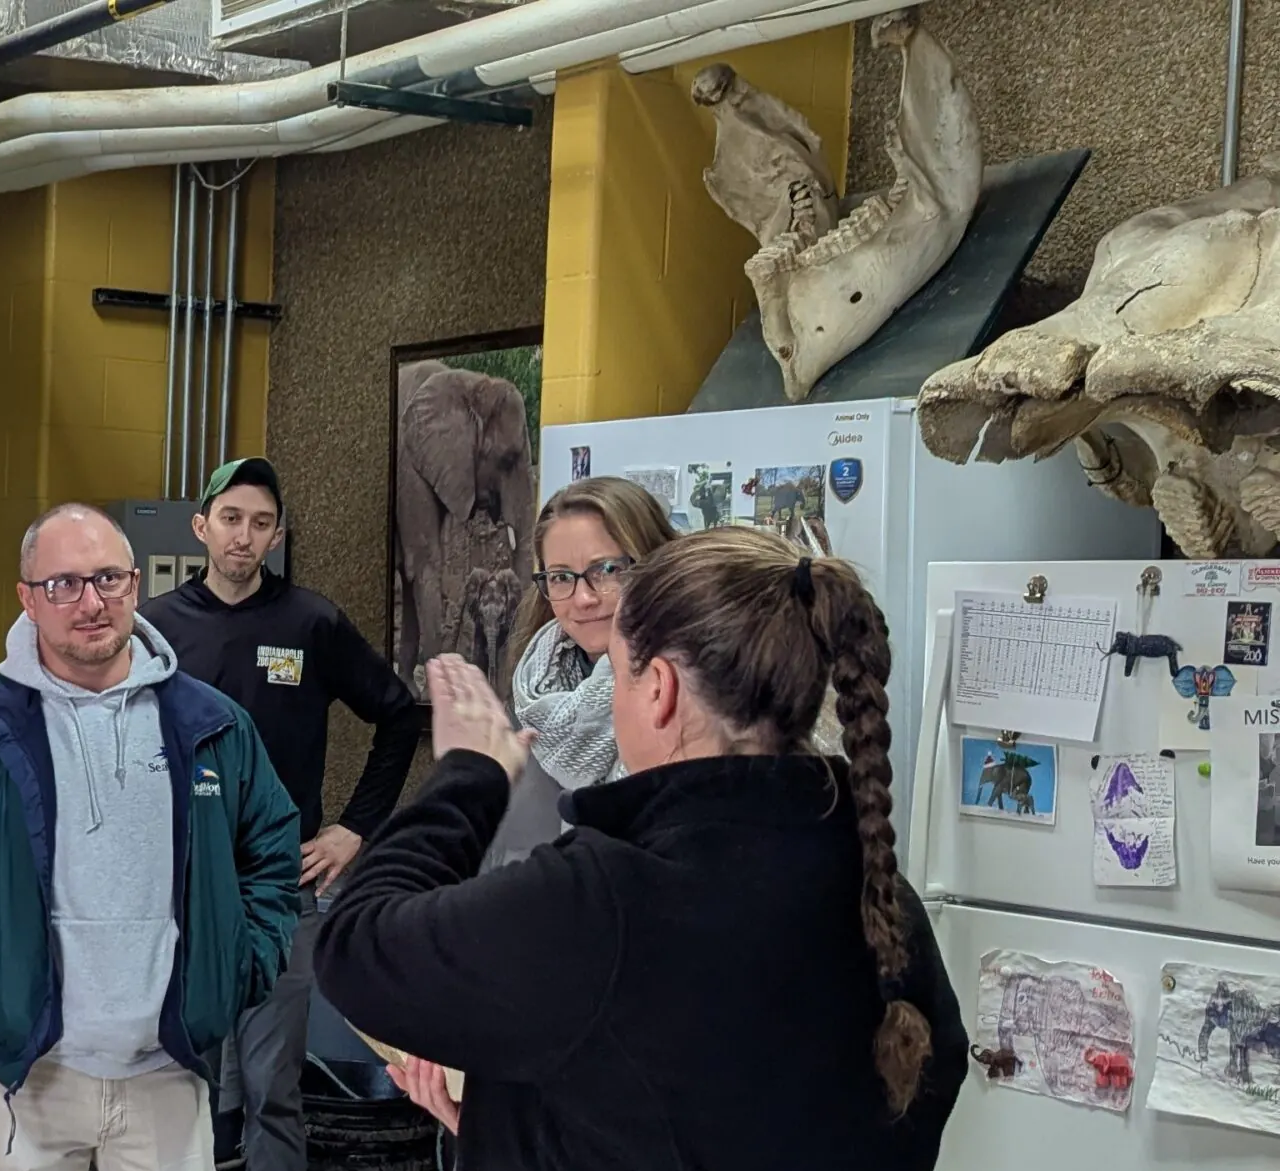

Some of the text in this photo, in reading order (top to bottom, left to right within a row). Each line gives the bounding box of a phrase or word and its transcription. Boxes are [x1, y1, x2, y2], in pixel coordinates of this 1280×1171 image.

[835, 413, 870, 422] Animal Only
[828, 431, 863, 446] Midea
[842, 467, 849, 477] 2
[257, 645, 304, 660] INDIANAPOLIS
[1248, 857, 1266, 865] Have
